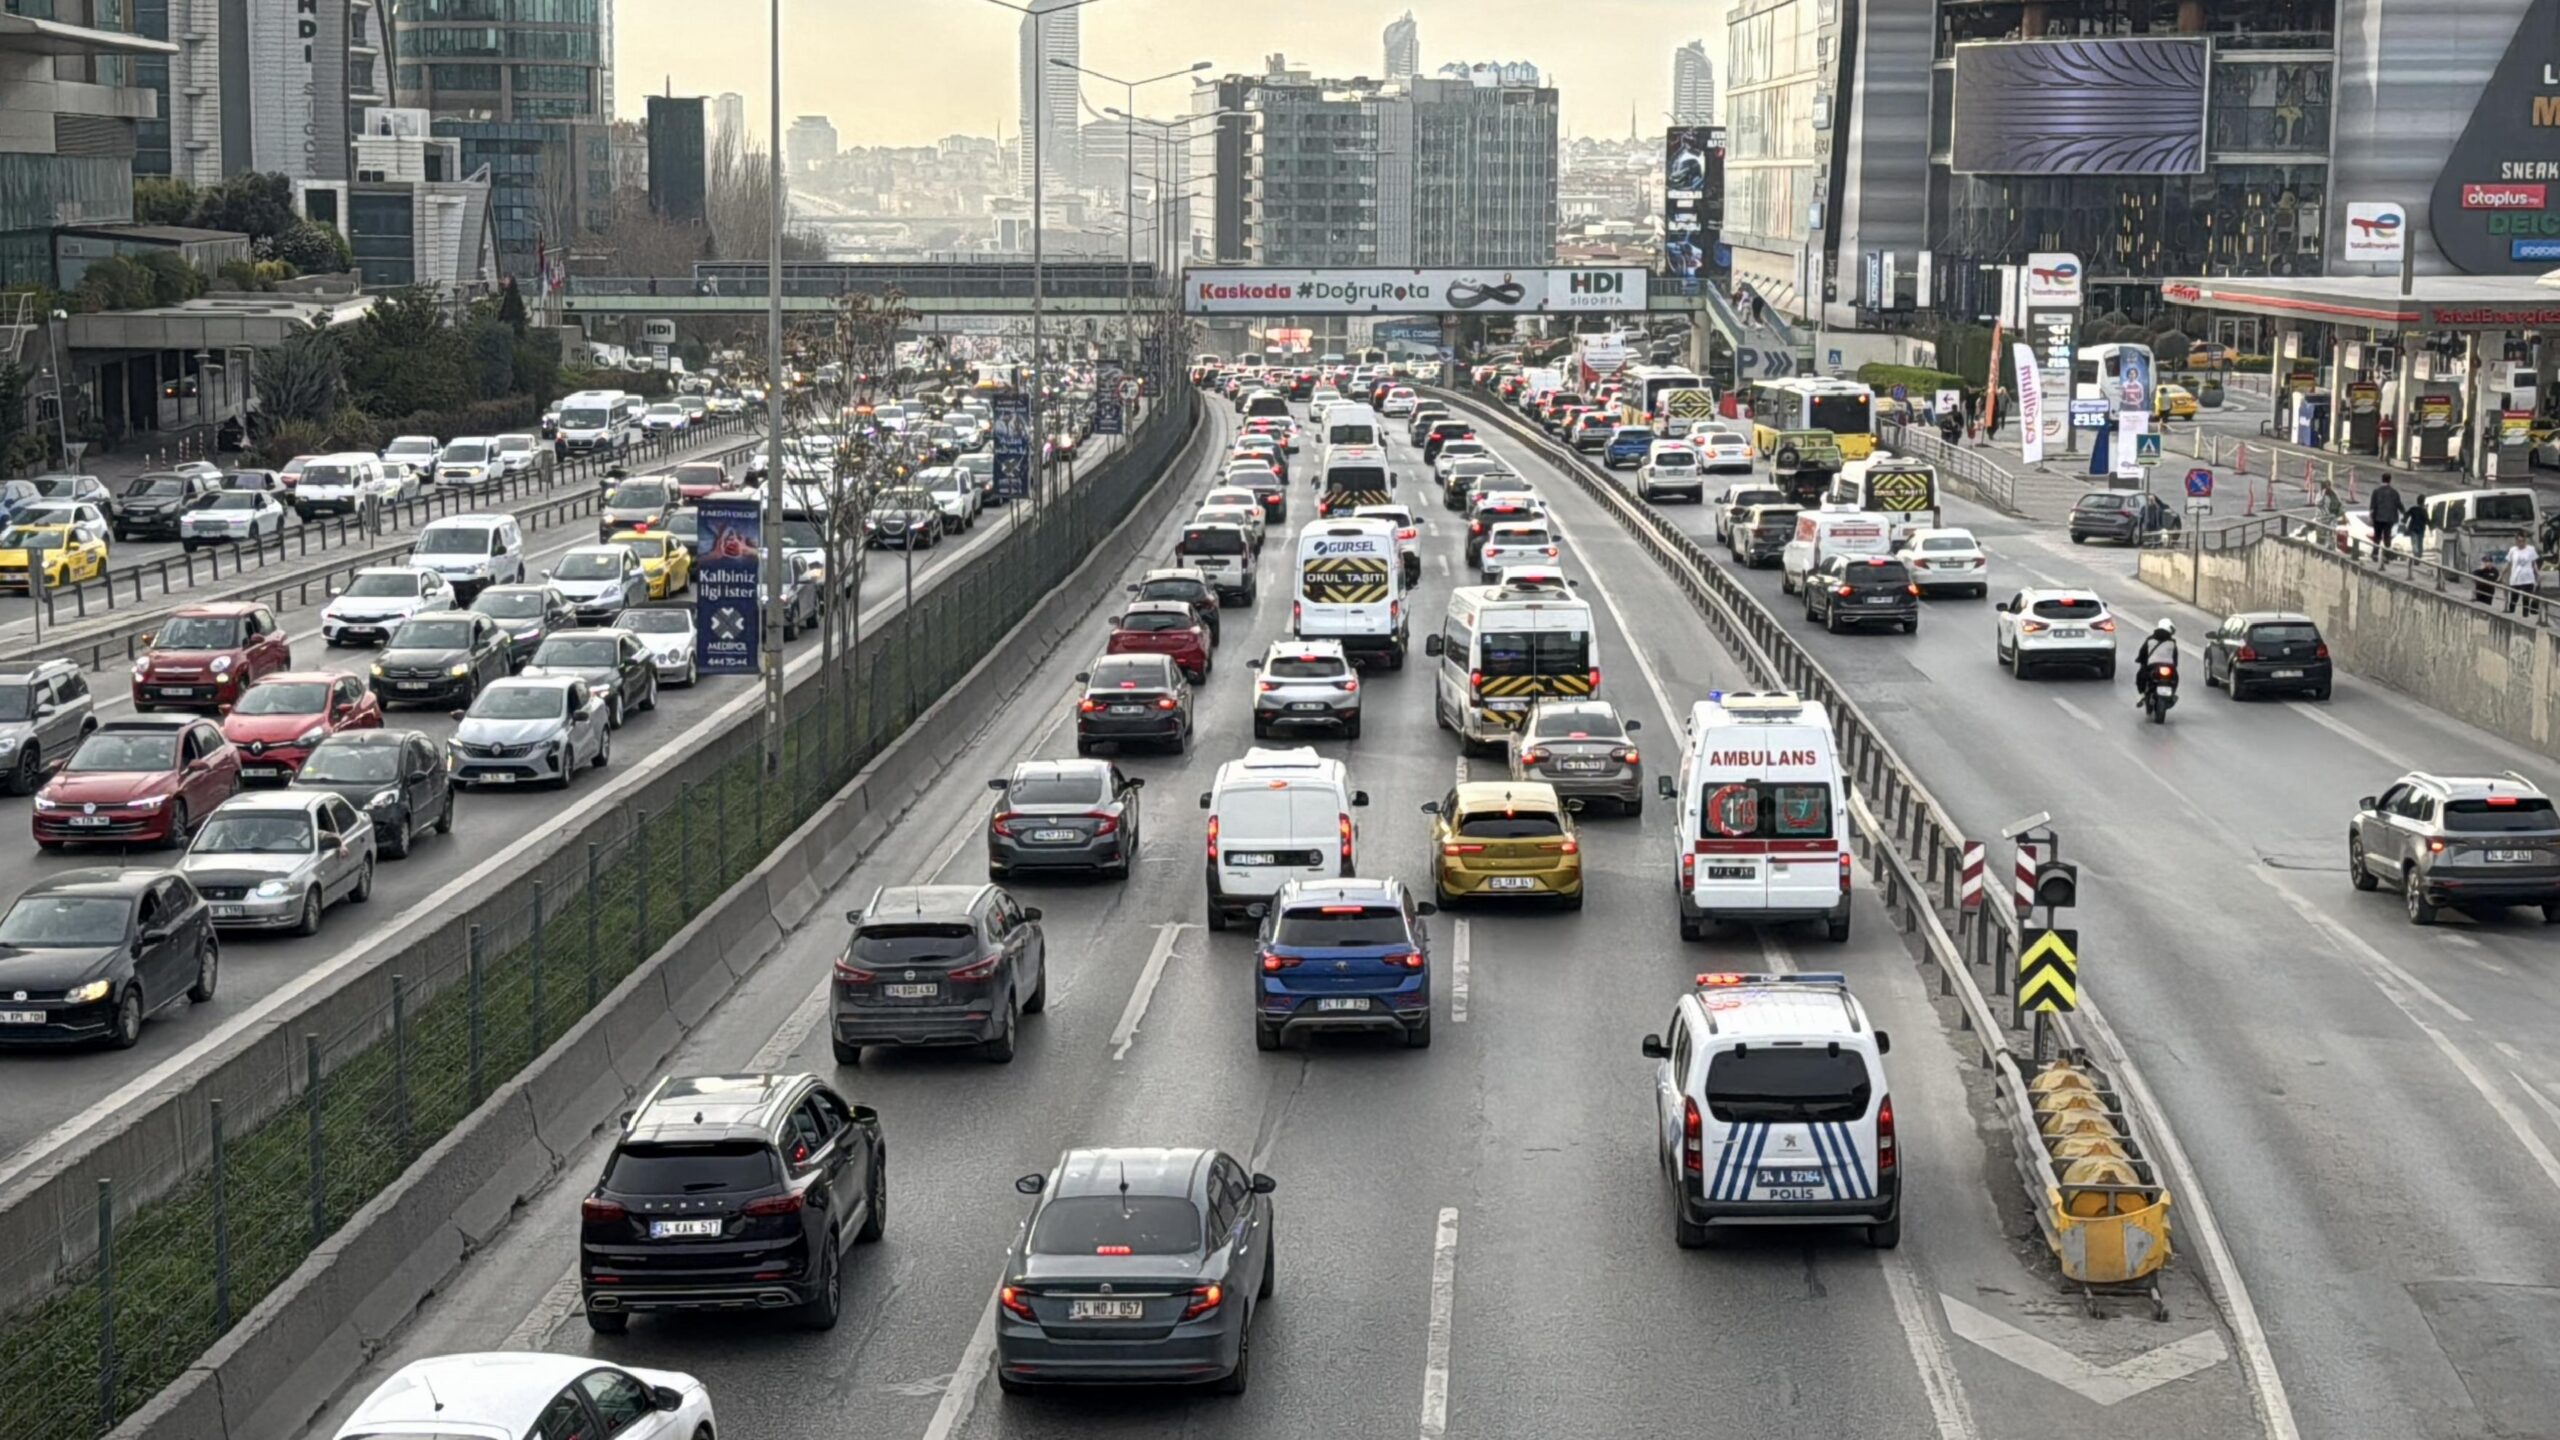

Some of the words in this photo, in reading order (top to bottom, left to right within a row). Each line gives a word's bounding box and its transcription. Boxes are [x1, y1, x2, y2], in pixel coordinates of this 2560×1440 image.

[2543, 63, 2560, 85] L
[2501, 161, 2559, 179] SNEAK
[1570, 272, 1623, 293] HDI
[1201, 283, 1292, 300] Kaskoda
[647, 324, 671, 335] HDI
[1739, 352, 1758, 374] P
[699, 569, 756, 583] Kalbiniz
[1306, 573, 1342, 583] OKUL
[700, 583, 722, 601] ilgi
[724, 584, 754, 598] ister
[1710, 751, 1817, 766] AMBULANS
[1761, 1170, 1775, 1182] 34
[1779, 1170, 1786, 1182] A
[1769, 1186, 1815, 1199] POLİS
[660, 1222, 670, 1233] 34
[701, 1221, 719, 1232] 517
[1076, 1302, 1088, 1314] 34
